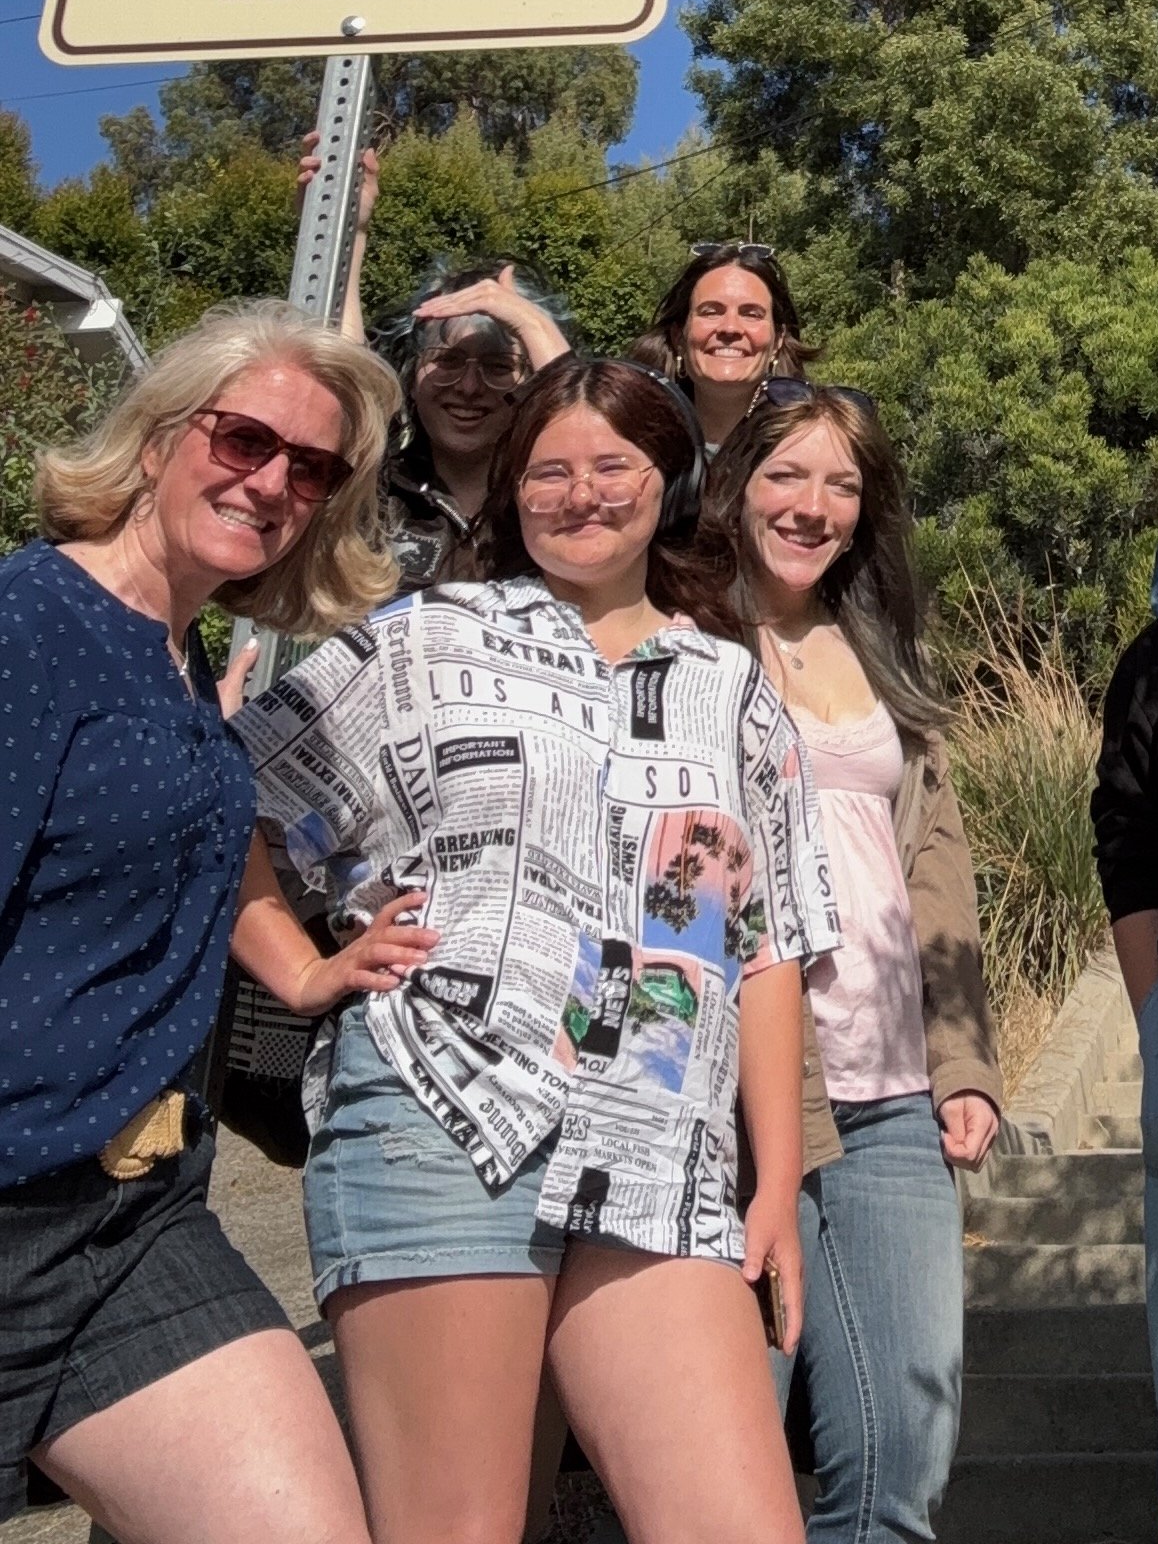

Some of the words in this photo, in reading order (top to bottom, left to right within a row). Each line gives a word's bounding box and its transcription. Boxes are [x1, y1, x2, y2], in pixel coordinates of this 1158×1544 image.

[386, 616, 414, 713] Tribune
[481, 629, 585, 676] EXTRA!
[429, 669, 507, 702] LOS
[291, 745, 337, 785] EXTRA!
[439, 748, 515, 769] INFORMATION
[442, 740, 507, 756] IMPORTANT
[645, 765, 720, 800] LOS
[434, 828, 516, 853] BREAKING
[609, 805, 626, 880] BREAKING
[621, 834, 639, 887] NEWS!
[481, 1031, 540, 1076] MEETING
[488, 1074, 527, 1122] Recovery
[524, 1120, 536, 1134] to
[594, 1148, 634, 1166] MARKETS
[635, 1157, 658, 1173] OPEN
[601, 1136, 631, 1152] LOCAL
[631, 1144, 651, 1157] FISH
[695, 1125, 726, 1257] DAILY
